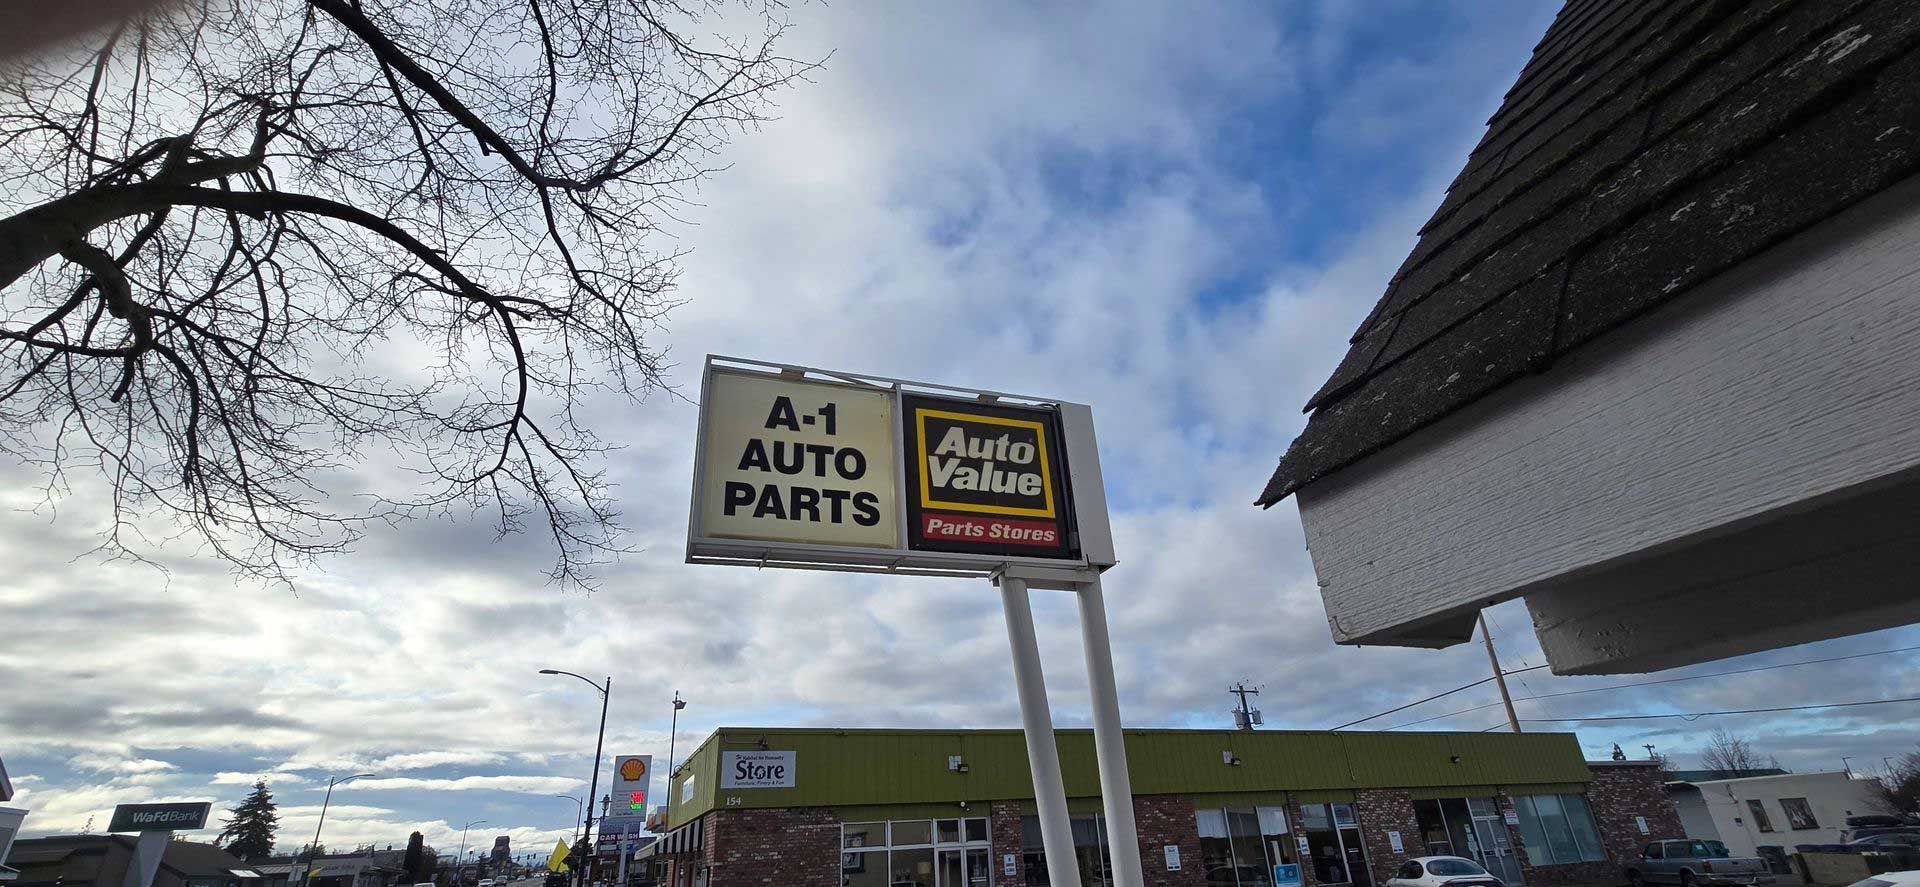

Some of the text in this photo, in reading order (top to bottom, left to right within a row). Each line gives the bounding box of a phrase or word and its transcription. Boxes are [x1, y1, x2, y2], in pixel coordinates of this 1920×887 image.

[764, 395, 837, 436] A-1
[737, 438, 867, 481] AUTO
[934, 426, 1035, 465] Auto
[928, 455, 1042, 496] Value
[723, 480, 881, 527] PARTS
[926, 518, 1055, 542] Parts Stores
[735, 760, 785, 780] Store
[726, 796, 742, 806] 154
[617, 832, 639, 841] WSH
